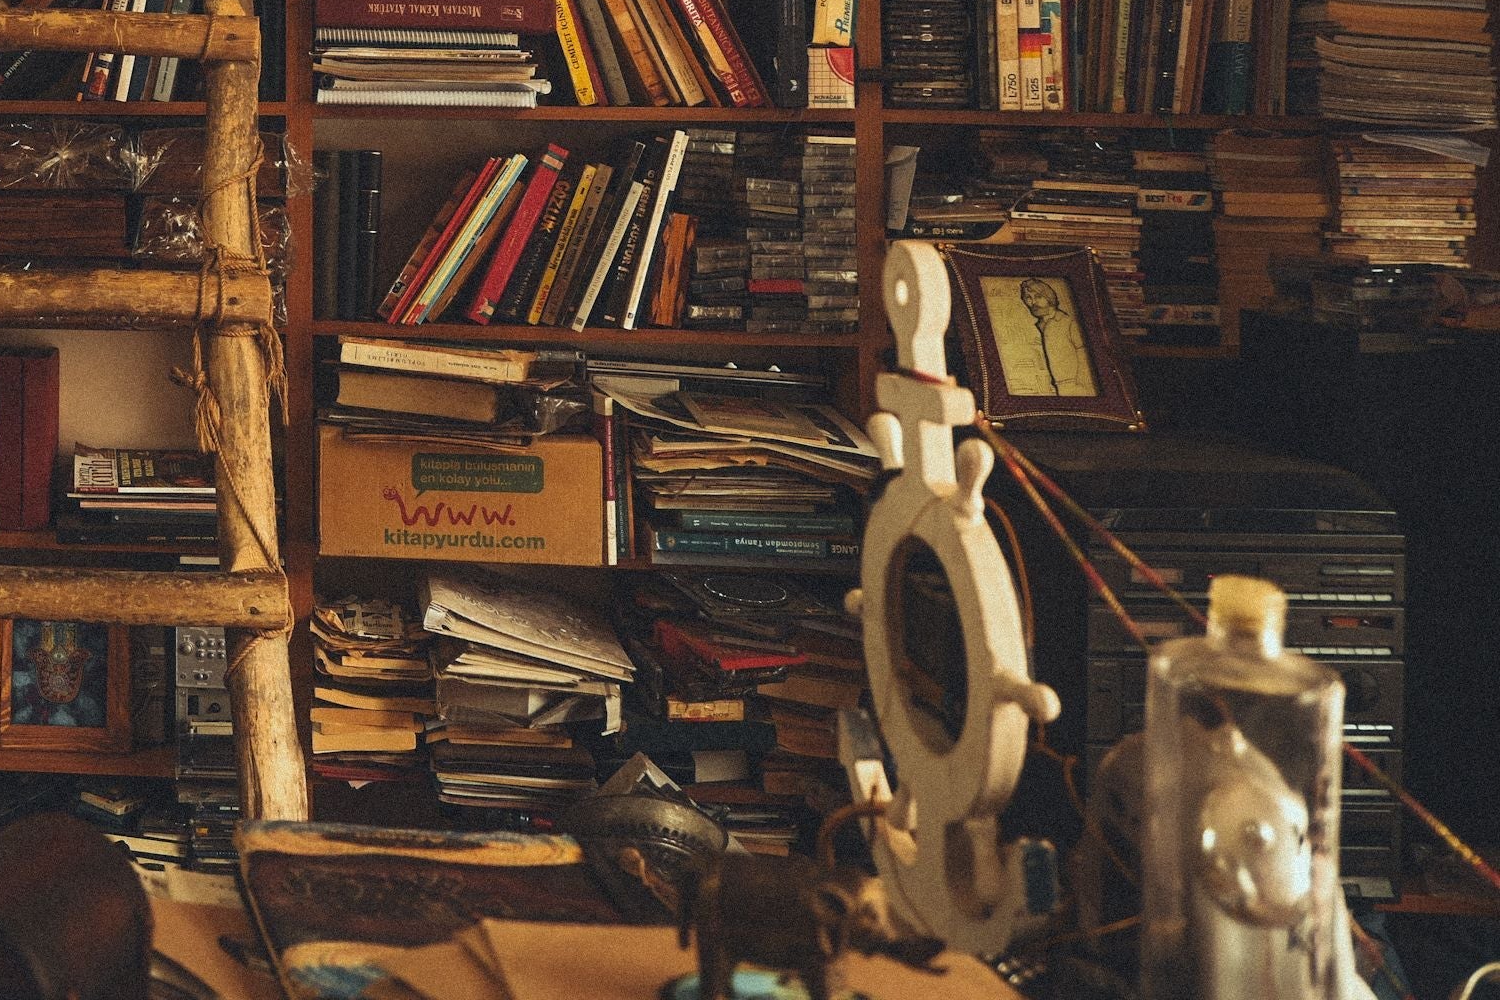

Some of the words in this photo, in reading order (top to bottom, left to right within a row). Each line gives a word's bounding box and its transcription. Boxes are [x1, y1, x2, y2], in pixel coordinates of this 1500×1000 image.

[367, 2, 406, 16] ATATÜRK
[406, 4, 441, 17] KEMAL
[441, 5, 482, 18] MUSTAFA
[1238, 3, 1250, 41] CLINIC
[1007, 73, 1017, 99] L-750
[1030, 78, 1040, 101] L-125
[419, 459, 462, 472] kitapla
[464, 458, 536, 473] buluşmanın
[419, 474, 436, 483] en
[438, 473, 472, 486] kolay
[383, 528, 546, 550] kitapyurdu.com
[734, 537, 764, 547] Tanıya
[765, 538, 820, 551] Semptomdan
[830, 543, 860, 554] LANGE
